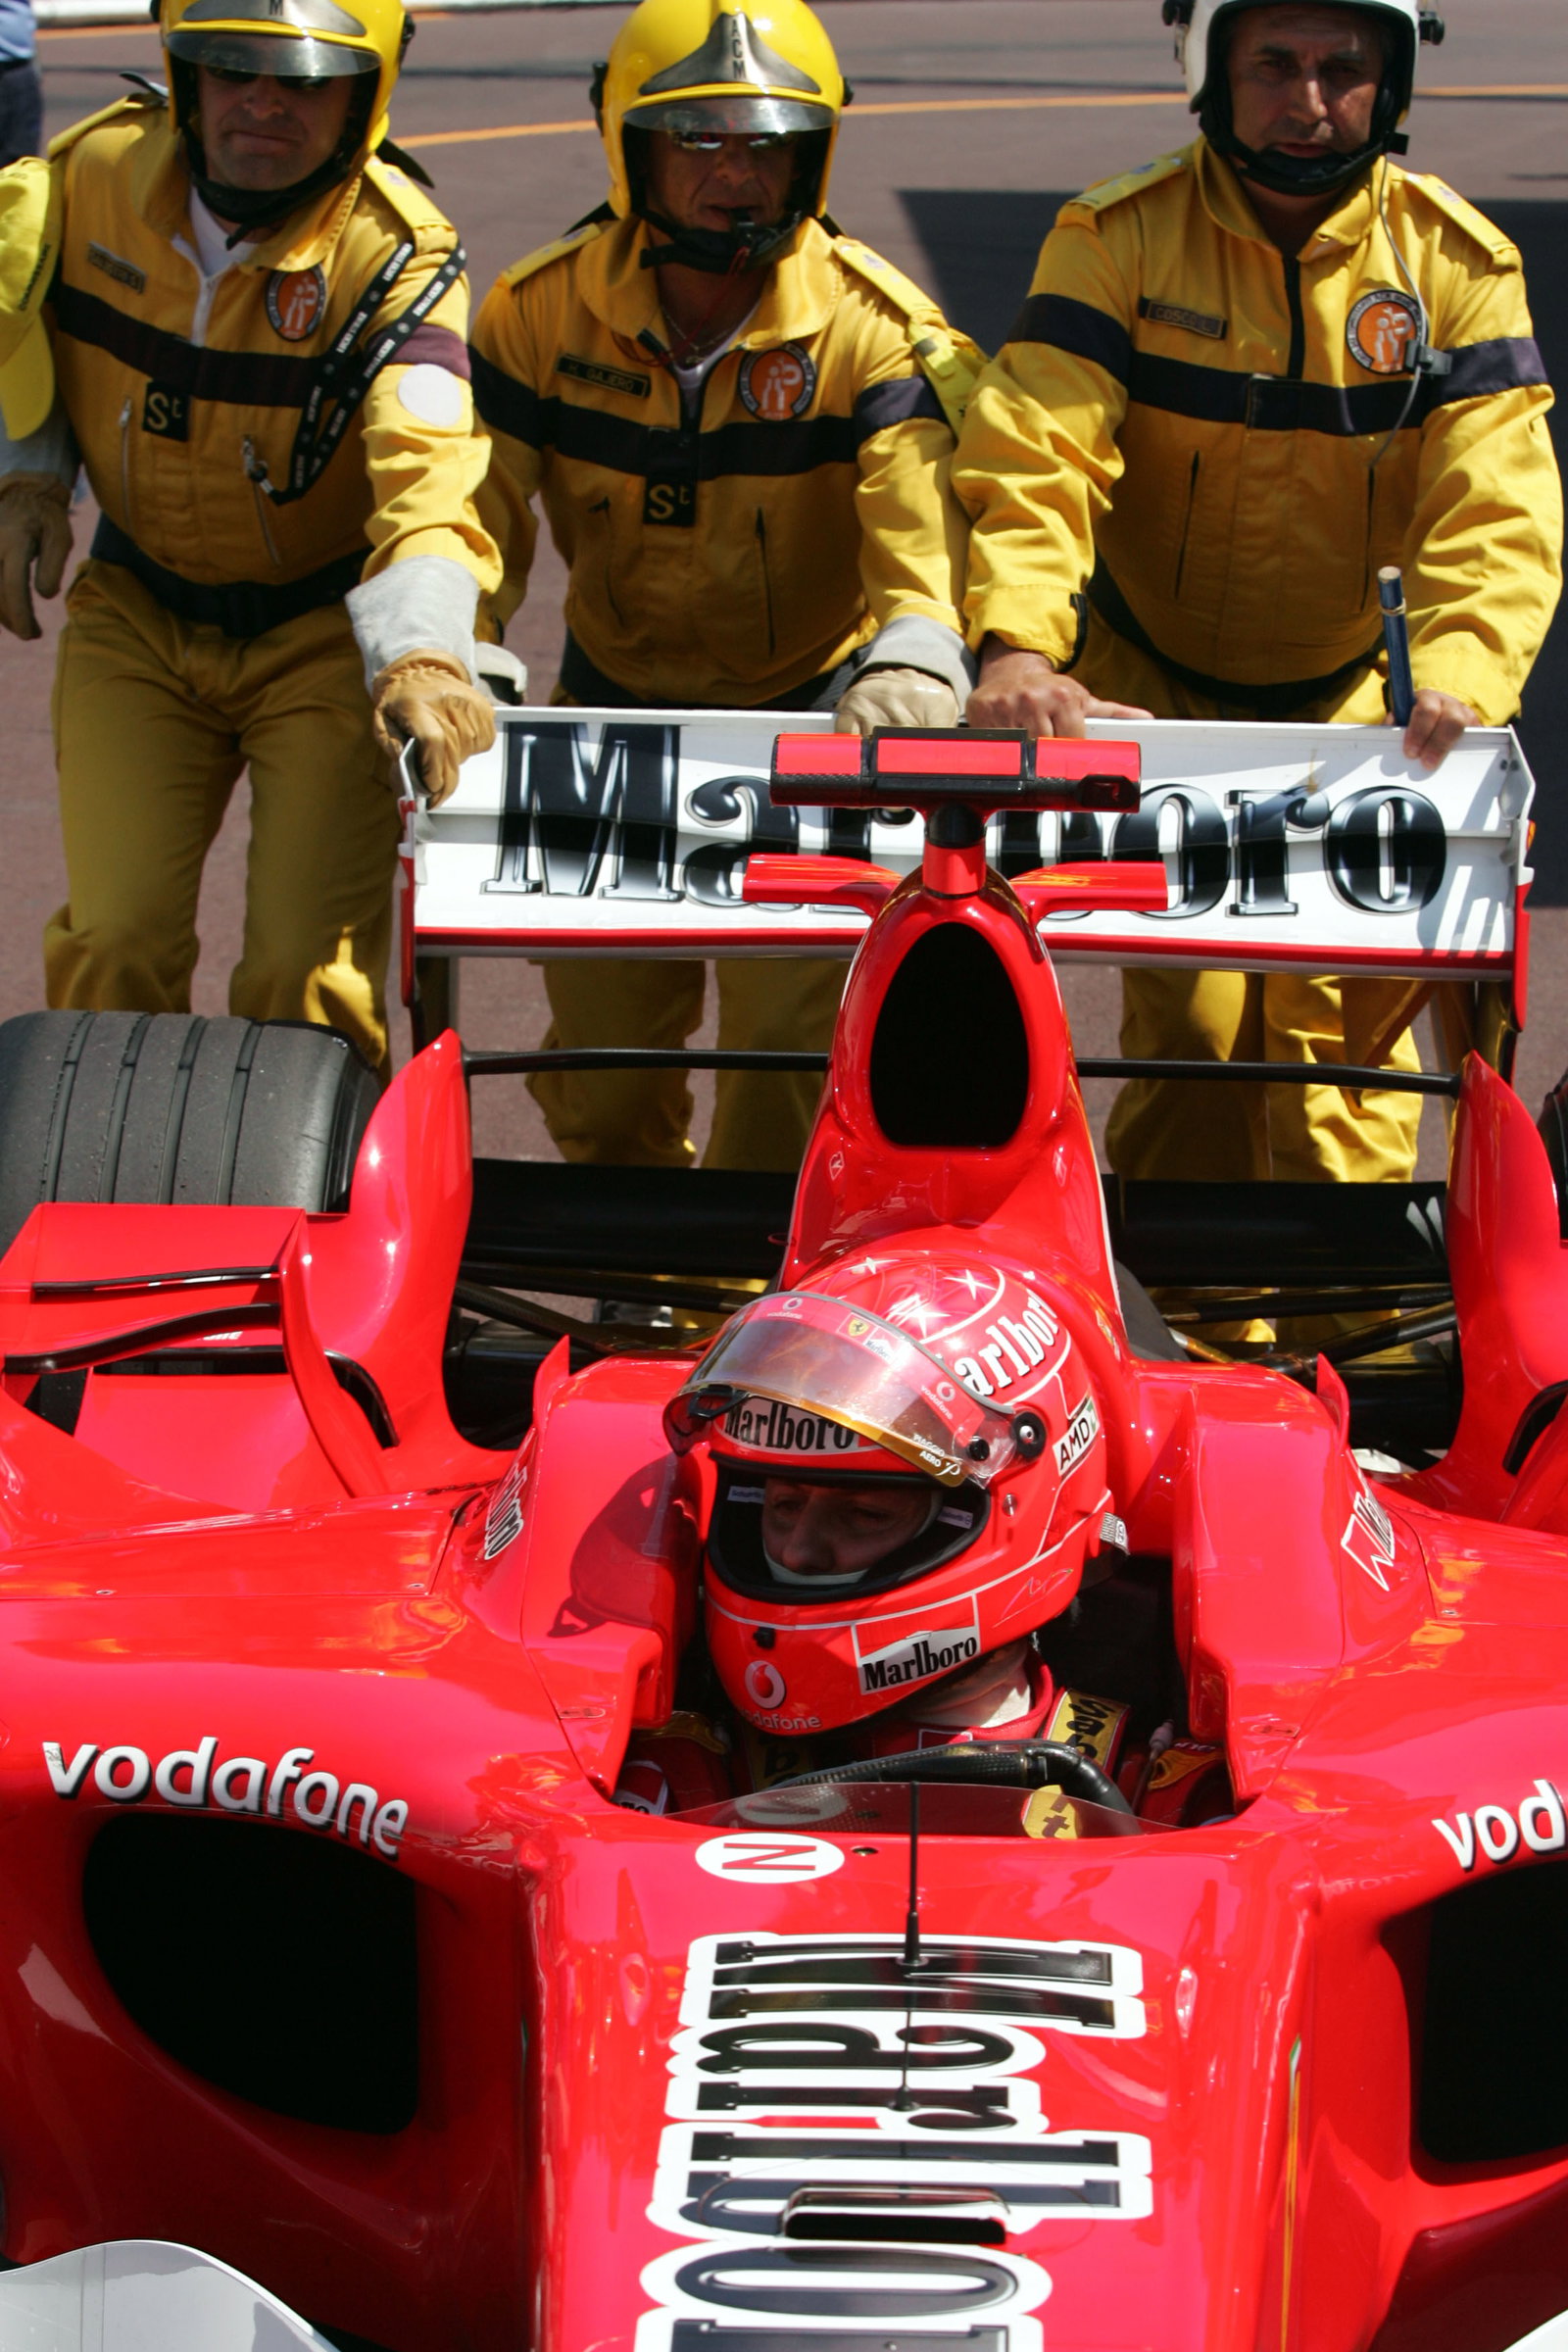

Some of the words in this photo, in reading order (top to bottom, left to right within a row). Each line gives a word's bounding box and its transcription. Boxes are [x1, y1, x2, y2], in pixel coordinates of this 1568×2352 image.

[480, 723, 1447, 920] Maoro
[955, 1288, 1058, 1396] arlbor
[921, 1385, 954, 1420] vodafone
[912, 1433, 946, 1458] PIAGGIO
[919, 1450, 942, 1468] AERO
[1059, 1417, 1092, 1470] AMD
[862, 1637, 978, 1691] Marlboro
[42, 1736, 410, 1858] vodafone
[1431, 1779, 1568, 1871] vod
